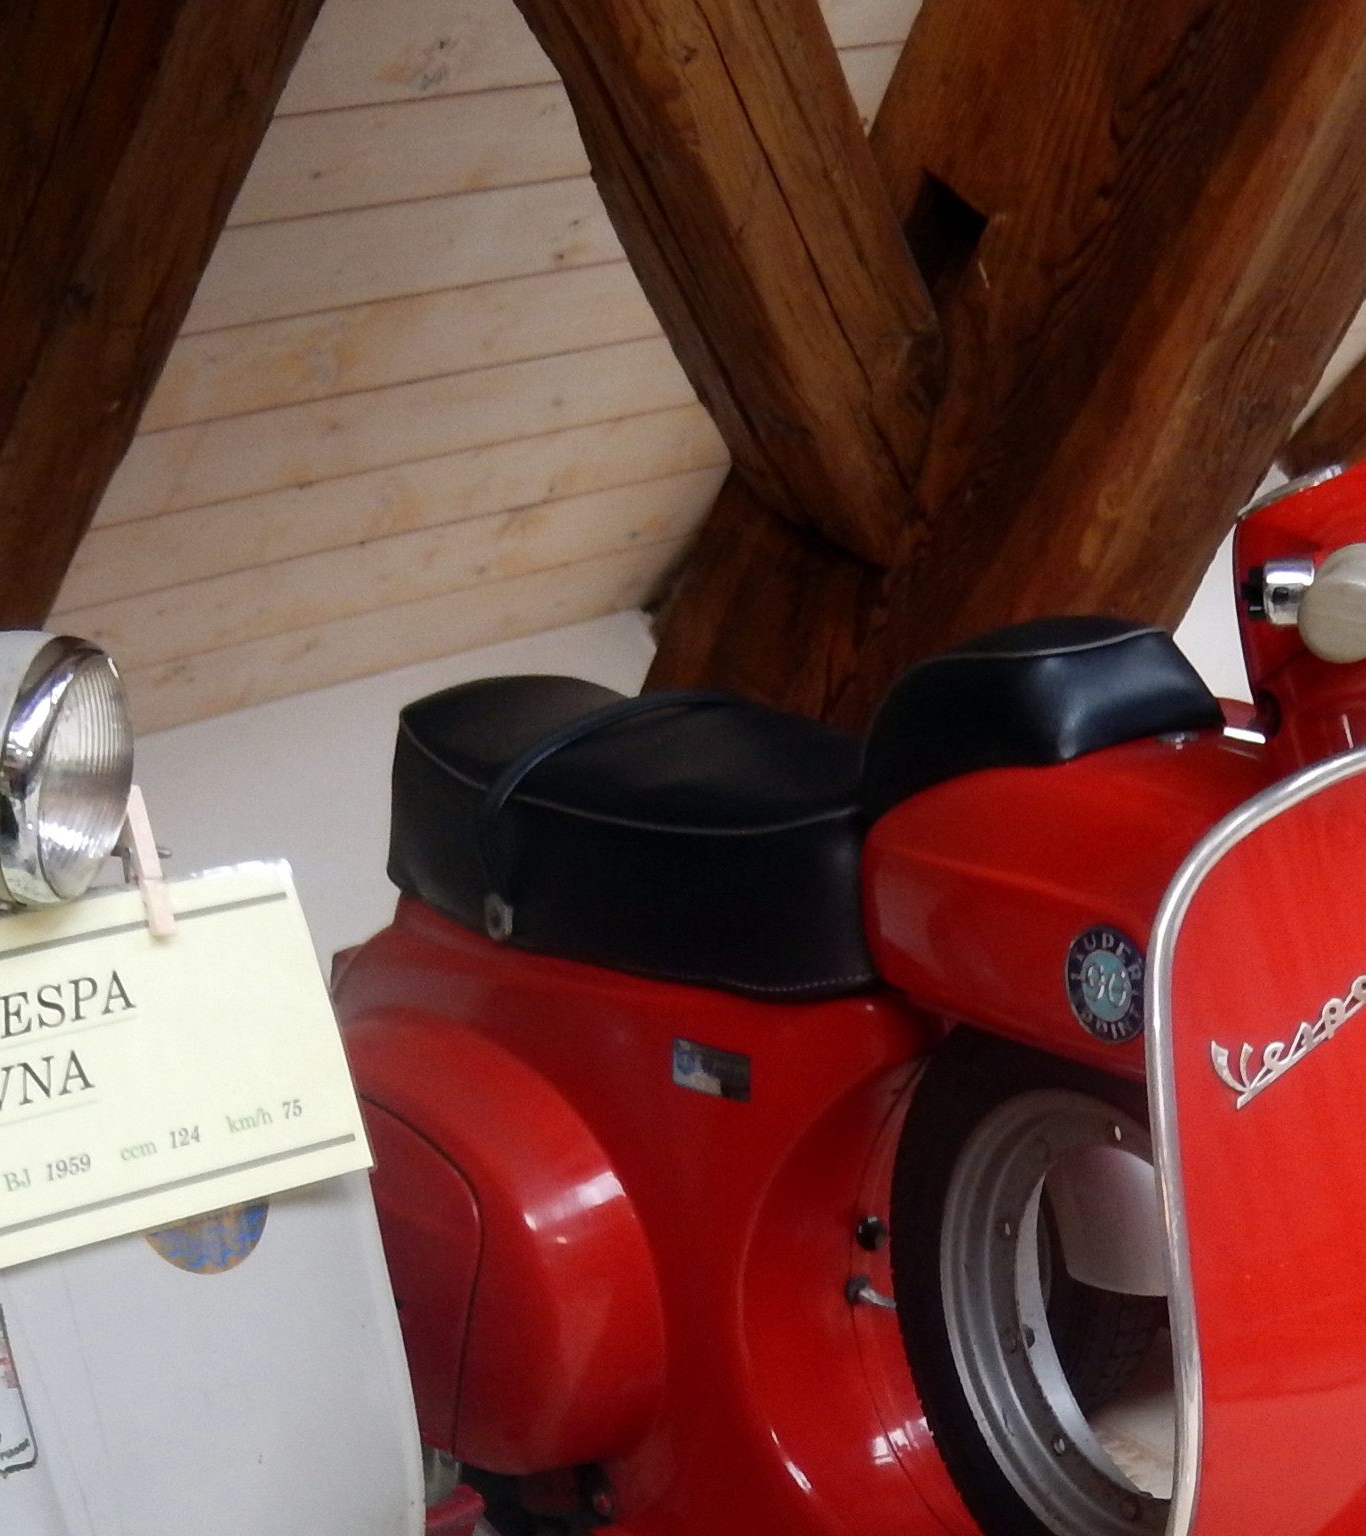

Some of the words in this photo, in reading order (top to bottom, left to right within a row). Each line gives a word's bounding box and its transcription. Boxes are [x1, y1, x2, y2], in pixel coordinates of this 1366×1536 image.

[2, 1167, 32, 1193] BJ
[45, 1153, 92, 1182] 1959
[120, 1138, 158, 1163] ccm
[169, 1125, 202, 1150] 124
[225, 1107, 275, 1135] km/h
[282, 1098, 304, 1121] 75
